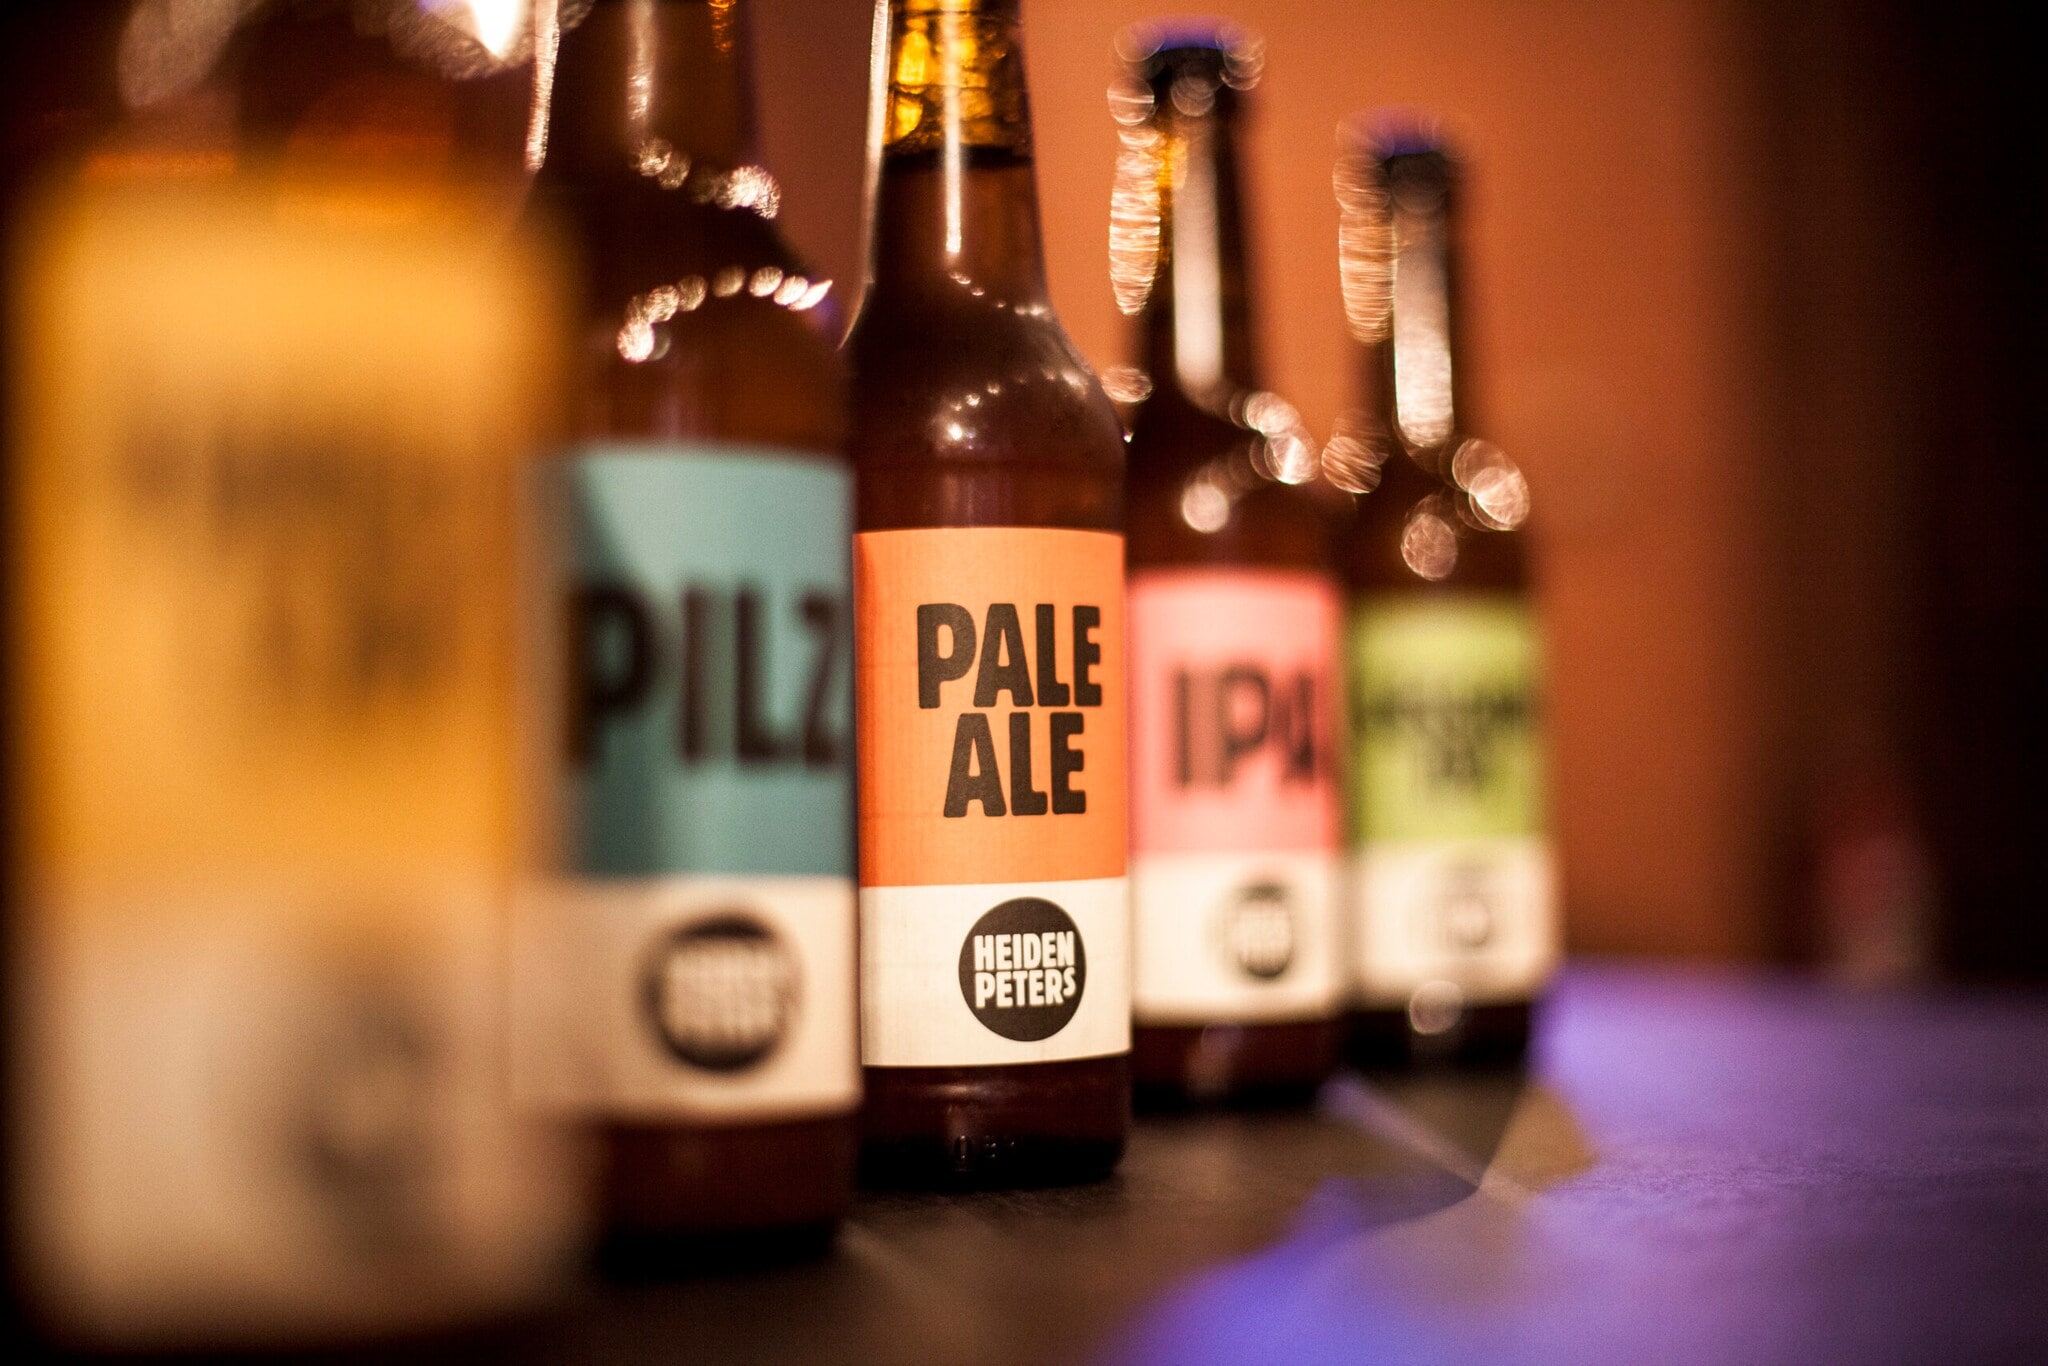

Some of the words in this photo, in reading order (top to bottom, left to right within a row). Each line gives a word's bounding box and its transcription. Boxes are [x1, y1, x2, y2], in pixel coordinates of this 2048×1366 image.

[917, 603, 1102, 709] PALE
[943, 712, 1086, 817] ALE
[974, 931, 1075, 972] HEIDEN
[975, 967, 1077, 1009] PETERS
